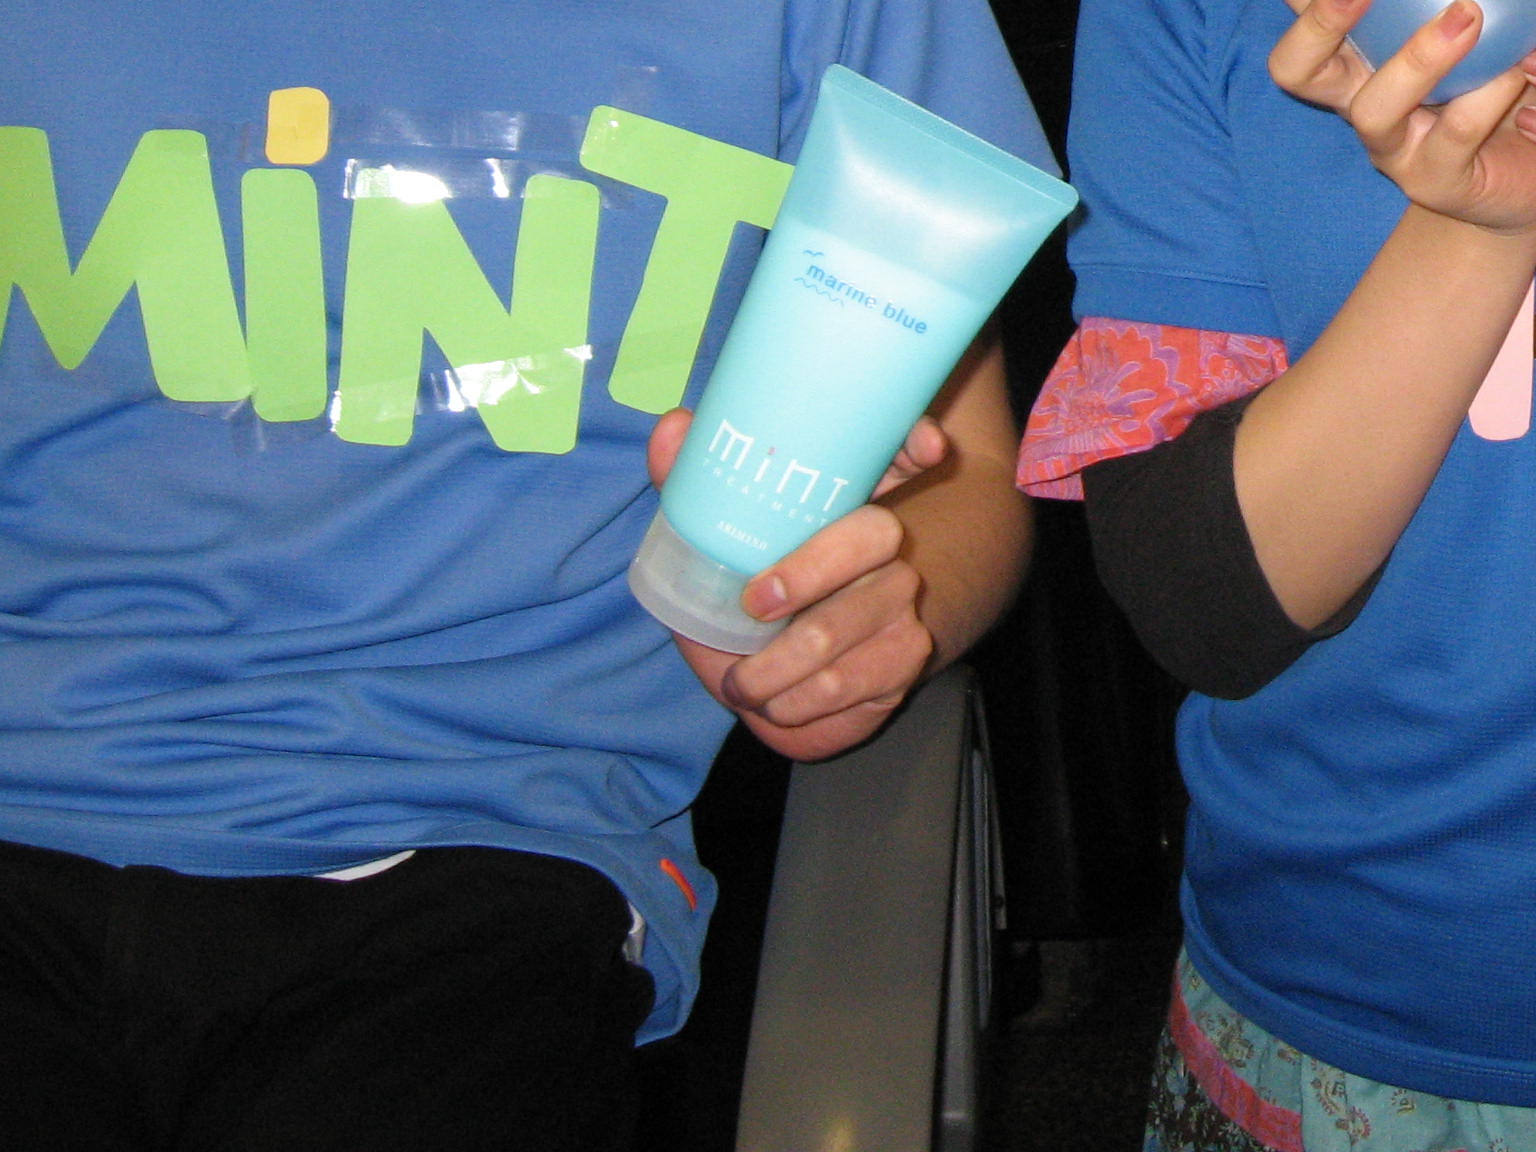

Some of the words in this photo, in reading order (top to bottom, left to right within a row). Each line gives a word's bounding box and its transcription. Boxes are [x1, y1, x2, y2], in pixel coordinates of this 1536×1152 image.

[806, 264, 878, 309] marine
[882, 302, 928, 335] blue
[708, 418, 849, 512] mint
